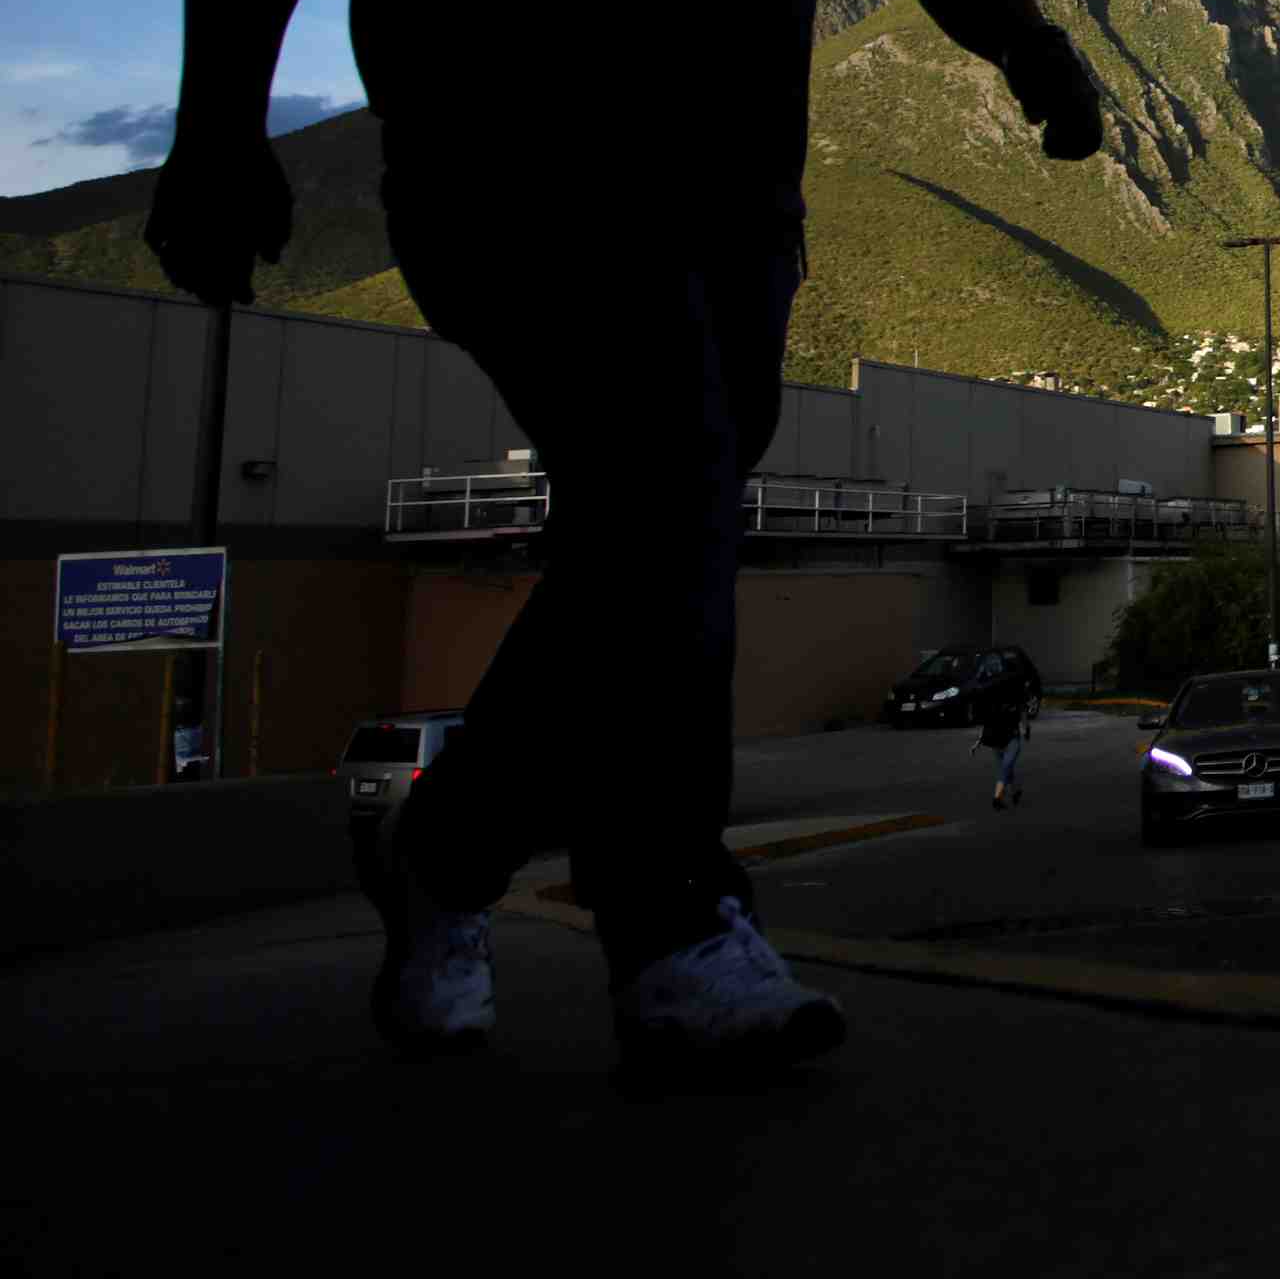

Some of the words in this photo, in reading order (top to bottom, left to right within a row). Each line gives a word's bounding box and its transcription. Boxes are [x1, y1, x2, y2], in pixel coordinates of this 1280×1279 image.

[112, 563, 156, 576] Walmart
[131, 592, 148, 602] QUE
[150, 591, 172, 601] PARA
[145, 616, 156, 627] DE
